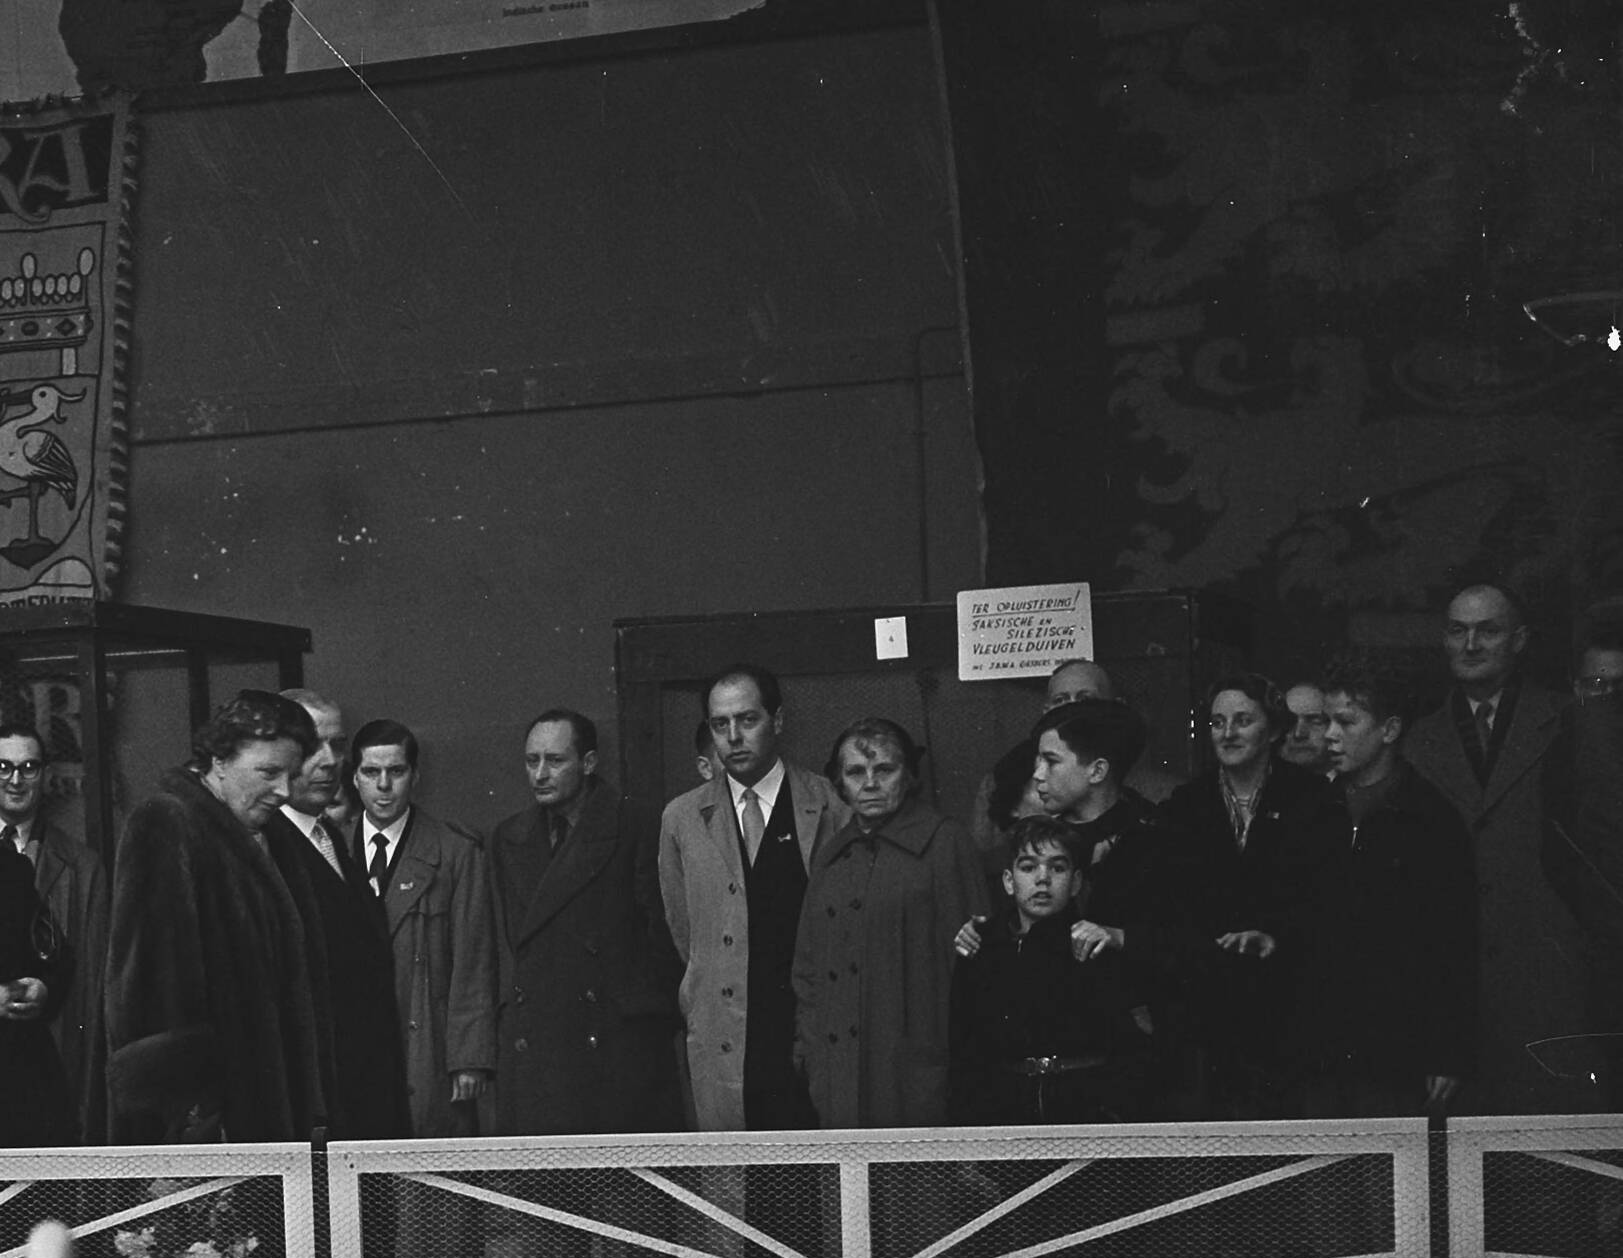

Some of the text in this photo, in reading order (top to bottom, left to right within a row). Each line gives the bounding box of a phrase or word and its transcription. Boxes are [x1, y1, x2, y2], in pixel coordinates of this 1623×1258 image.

[972, 603, 989, 614] TER
[972, 616, 1034, 632] SAKSISCHE
[1006, 625, 1076, 640] SILEZISCHE
[973, 639, 1076, 655] VLEUGELDUIVEN
